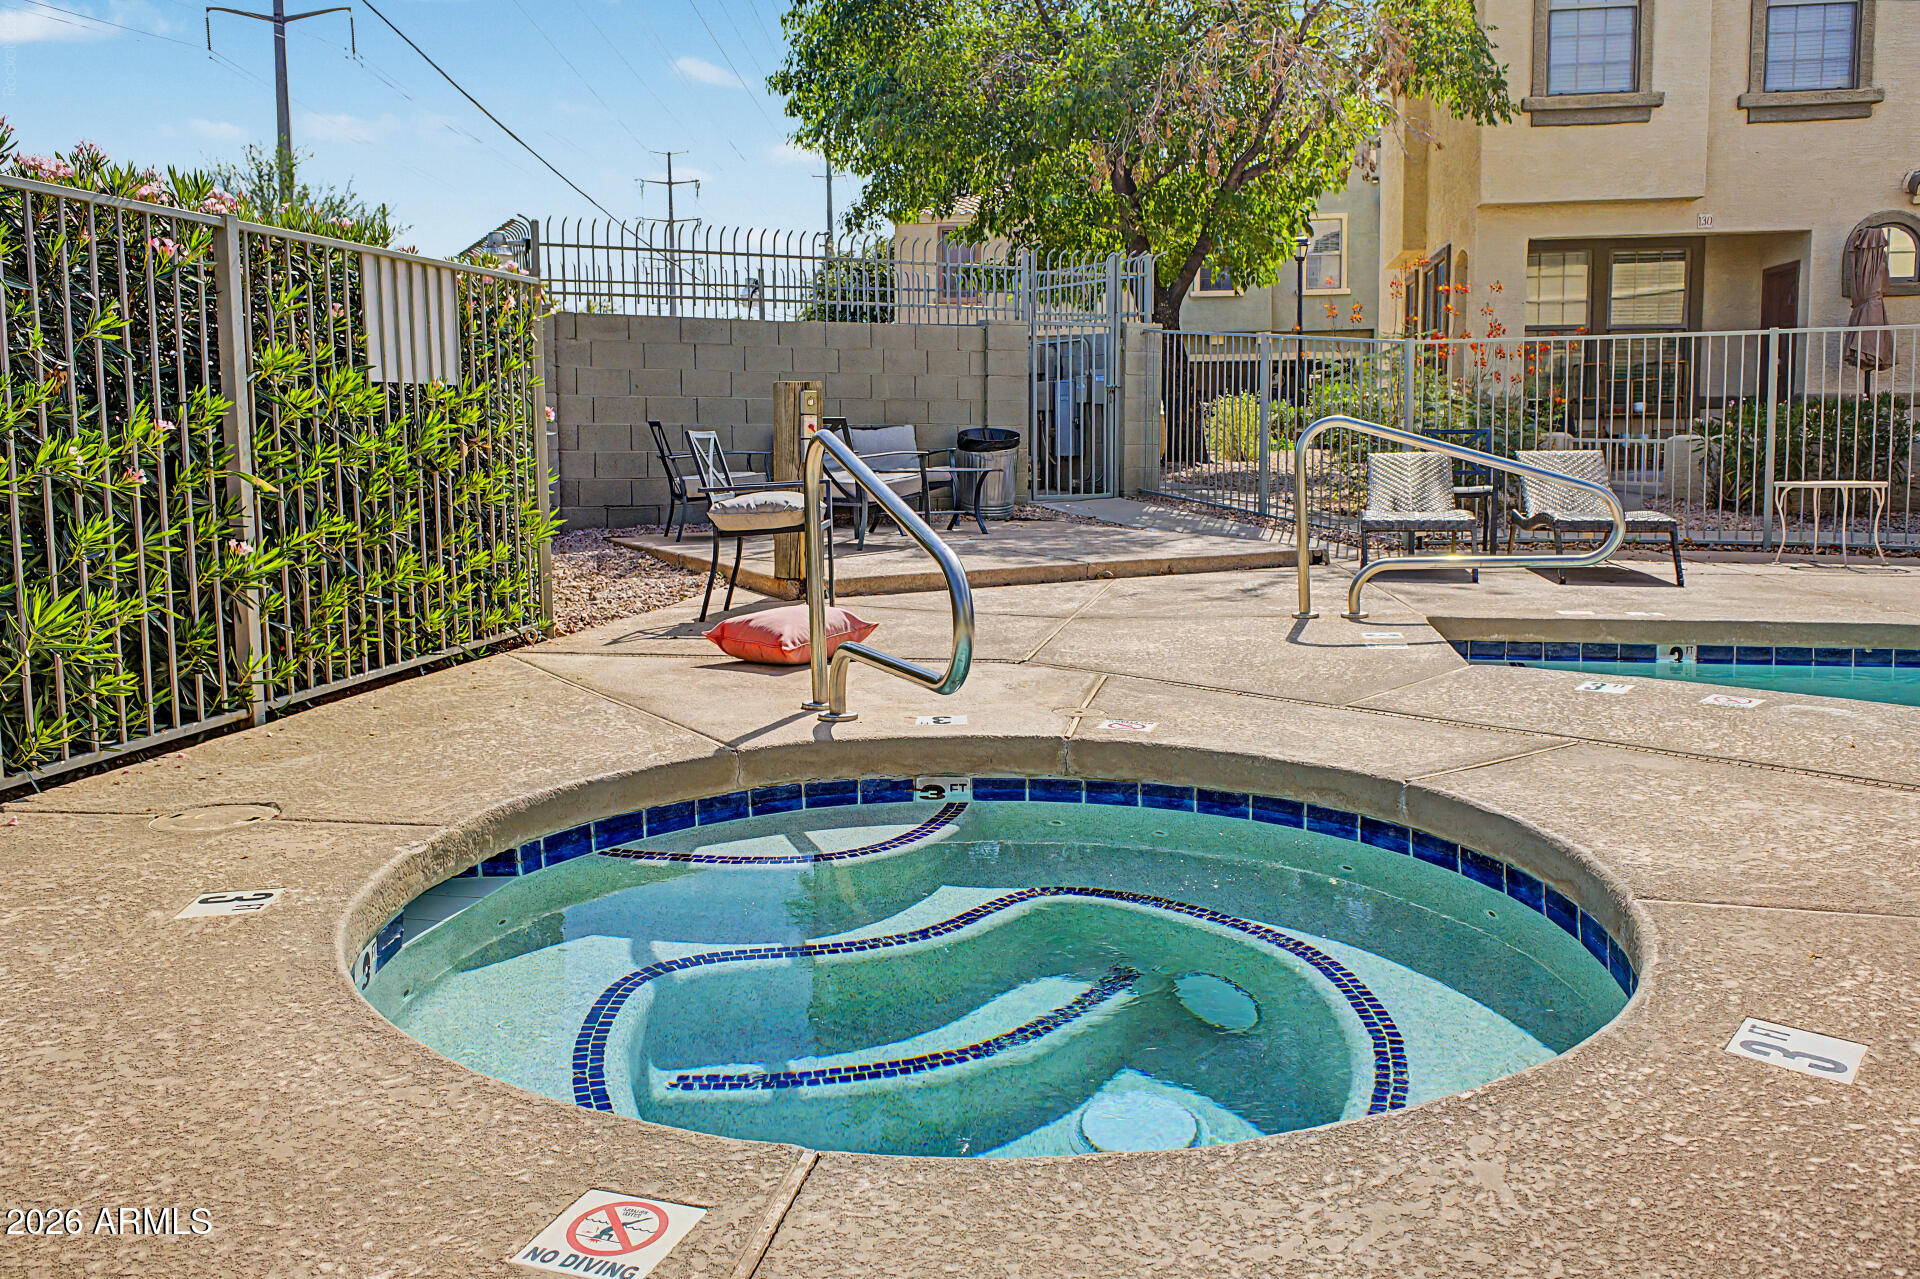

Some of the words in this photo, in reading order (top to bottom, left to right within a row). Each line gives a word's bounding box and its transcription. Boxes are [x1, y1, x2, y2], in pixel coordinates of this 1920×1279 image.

[1699, 216, 1713, 226] 130
[919, 784, 946, 800] 3
[950, 783, 968, 793] FT
[197, 892, 275, 905] 3
[1747, 1023, 1791, 1042] FT
[1739, 1039, 1849, 1074] 3
[521, 1246, 560, 1264] NO
[557, 1253, 640, 1279] DIVING
